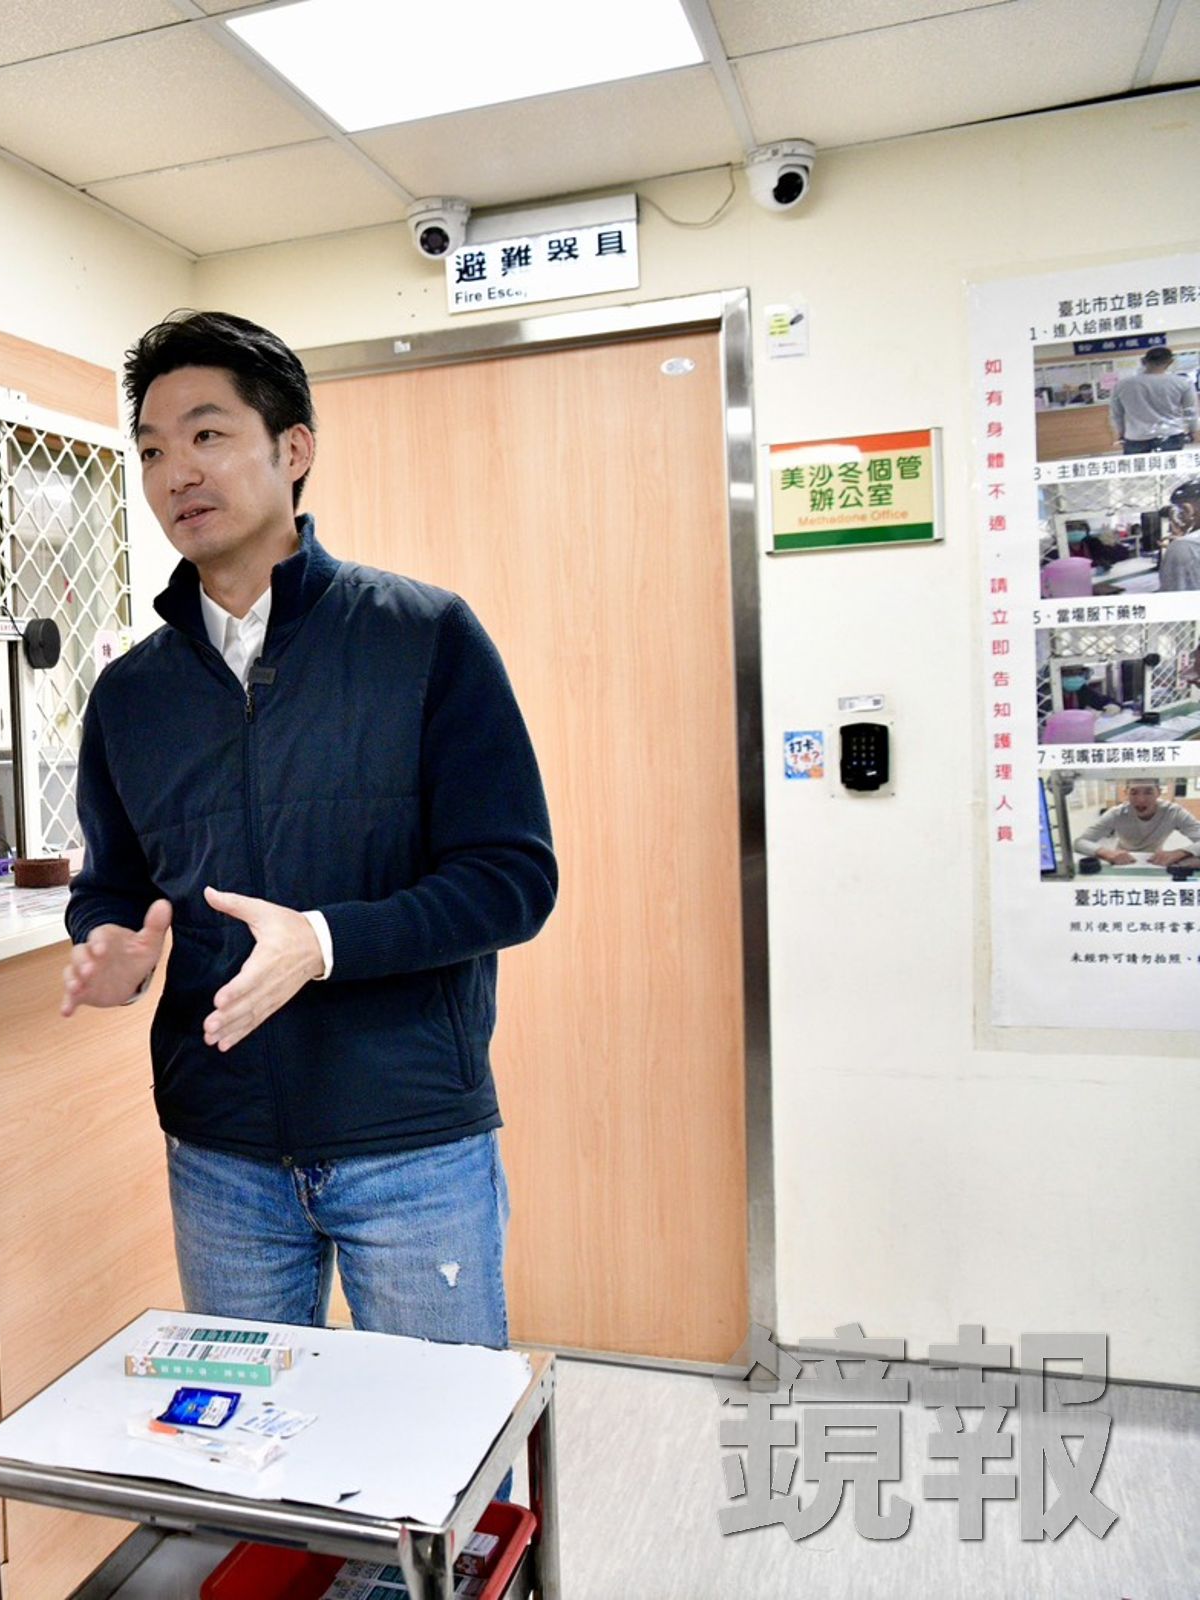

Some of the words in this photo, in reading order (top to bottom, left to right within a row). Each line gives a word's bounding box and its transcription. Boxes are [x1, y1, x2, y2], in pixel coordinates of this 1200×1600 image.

[455, 291, 483, 304] Fire
[1058, 285, 1200, 318] 臺北市立聯合醫院
[781, 455, 922, 490] 美沙冬個管
[809, 484, 894, 512] 辦公室
[798, 512, 868, 527] Methadone
[870, 509, 908, 522] Office
[1075, 889, 1200, 907] 臺北市立聯合醫
[1070, 921, 1200, 933] 照片使用已取得當事
[1071, 952, 1200, 964] 未經許可請勿拍照、
